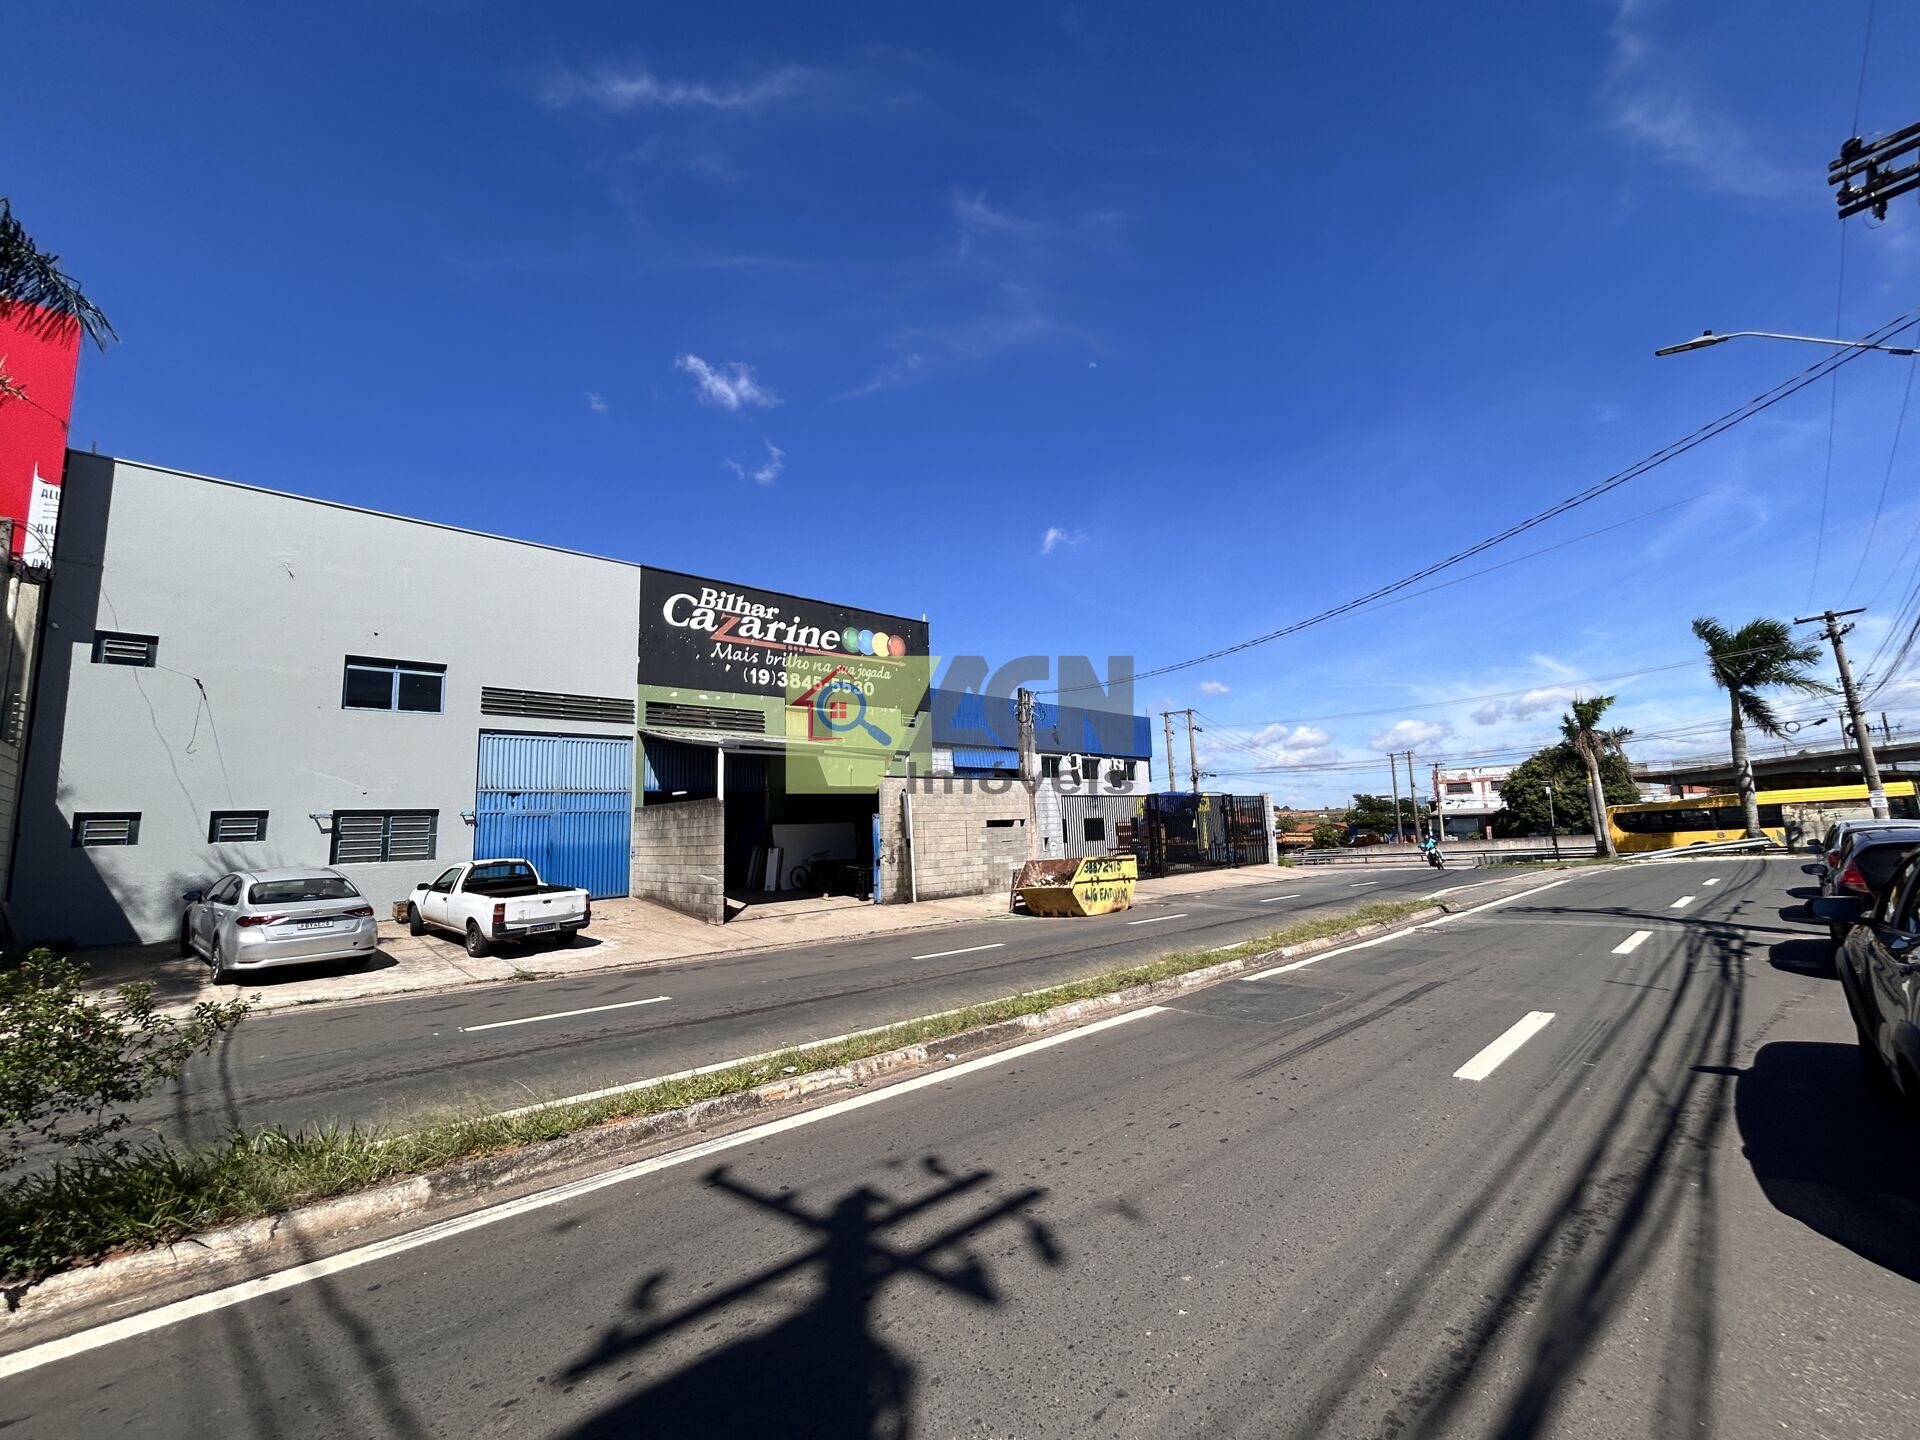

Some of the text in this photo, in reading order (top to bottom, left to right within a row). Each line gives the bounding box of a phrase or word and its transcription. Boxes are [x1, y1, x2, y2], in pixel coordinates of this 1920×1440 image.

[662, 593, 841, 650] Cazarine
[698, 587, 780, 619] Bilhar
[710, 642, 758, 664] Mais
[766, 649, 809, 671] brilho
[813, 663, 833, 673] na
[855, 665, 891, 682] jogada
